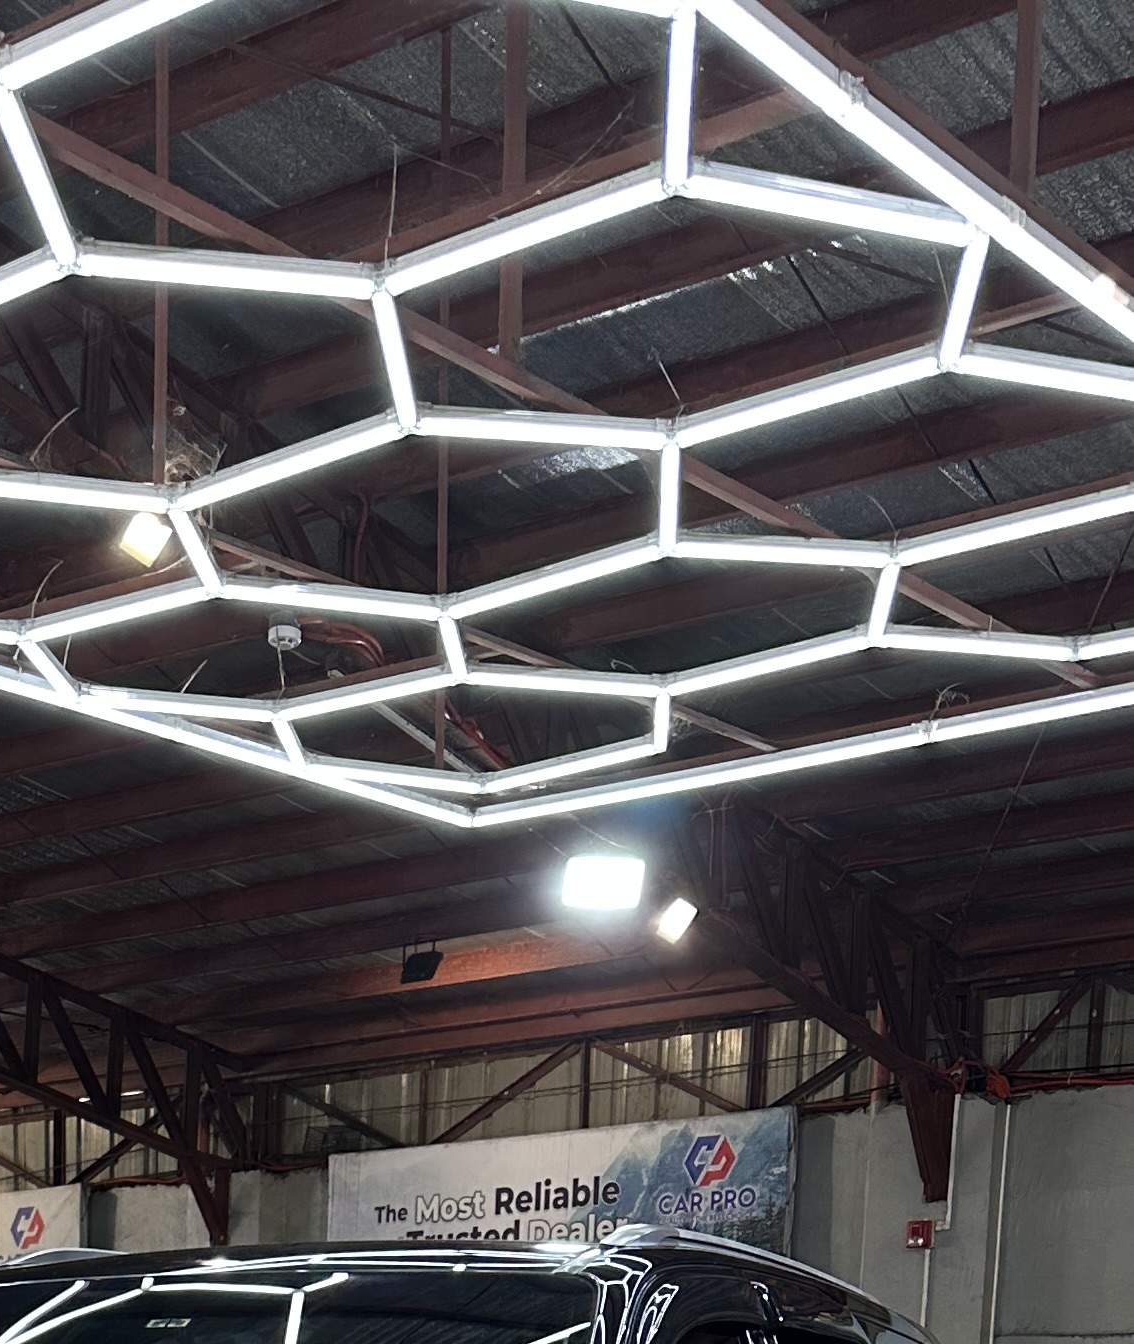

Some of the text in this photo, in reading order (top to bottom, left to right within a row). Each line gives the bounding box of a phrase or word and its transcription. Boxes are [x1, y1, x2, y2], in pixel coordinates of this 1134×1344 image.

[374, 1176, 621, 1225] The Most Reliable
[658, 1187, 757, 1215] CAR PRO
